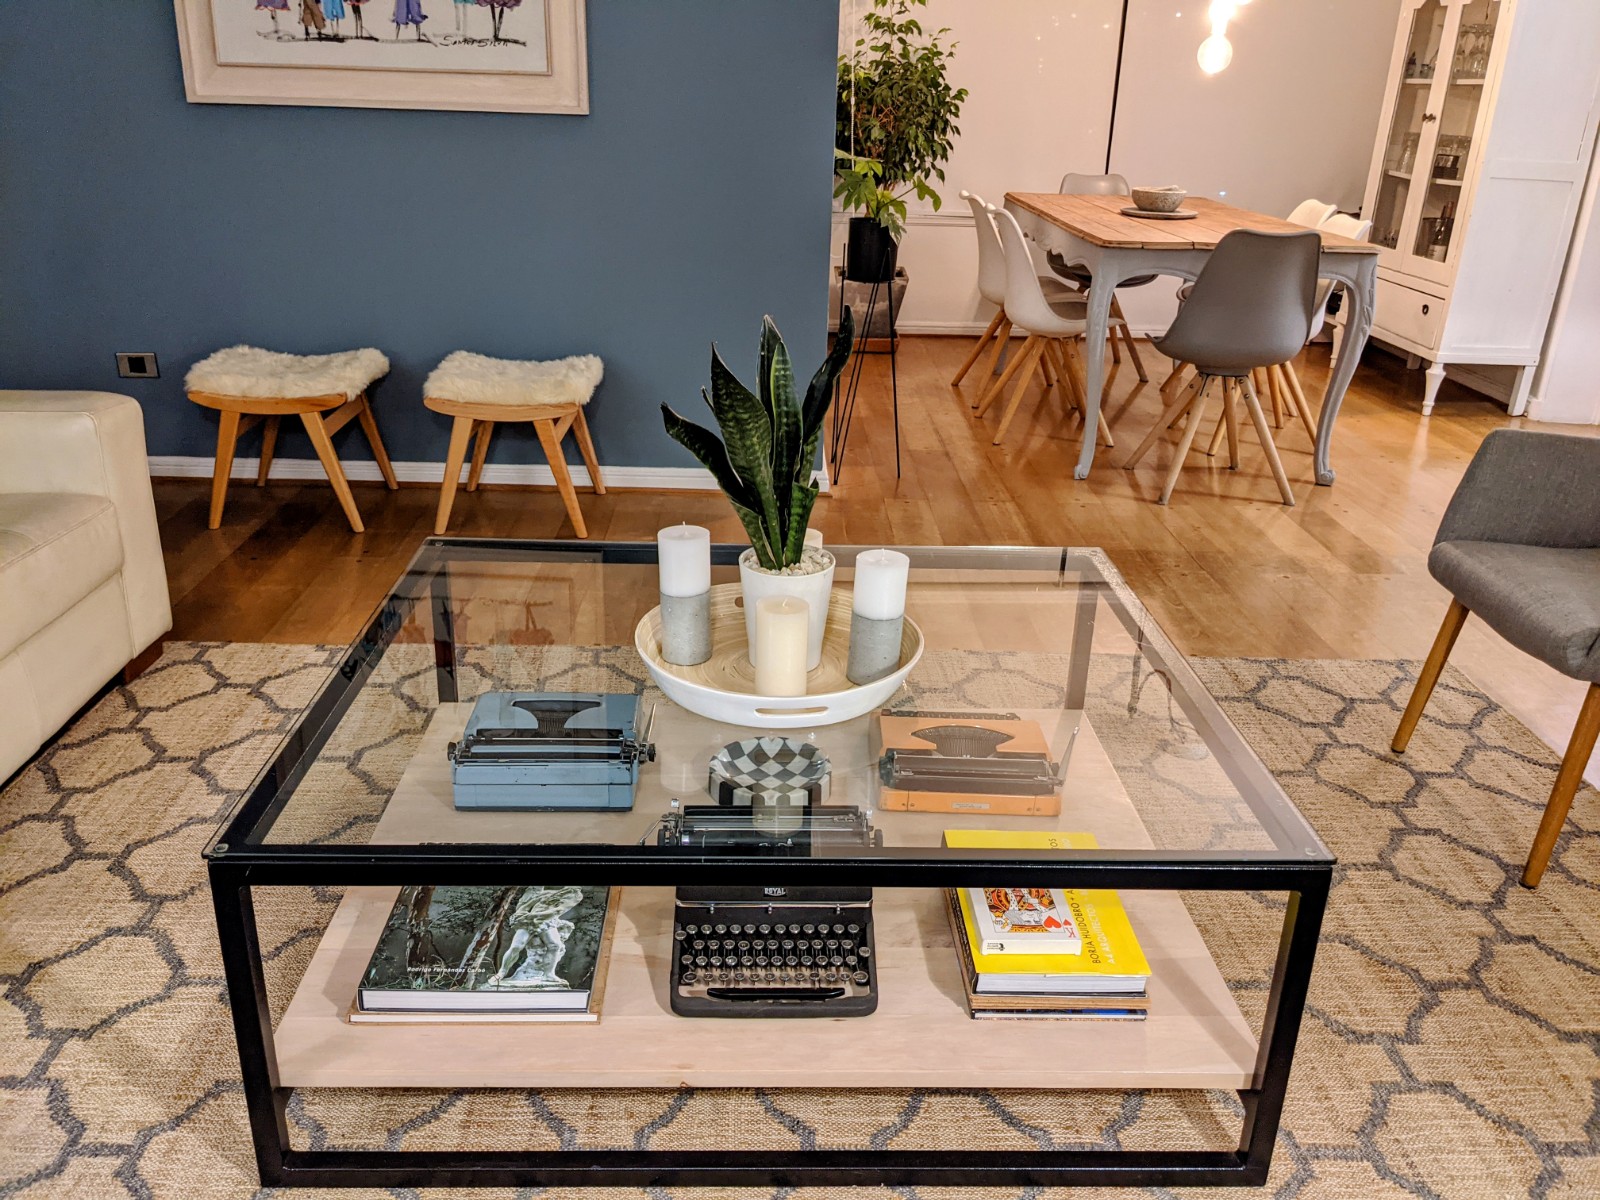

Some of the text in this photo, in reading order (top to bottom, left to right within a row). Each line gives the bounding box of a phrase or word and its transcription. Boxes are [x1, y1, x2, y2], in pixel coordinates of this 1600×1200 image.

[764, 887, 786, 896] ROYAL
[1070, 902, 1091, 939] HUIDOBRO
[1085, 941, 1101, 964] BORJA
